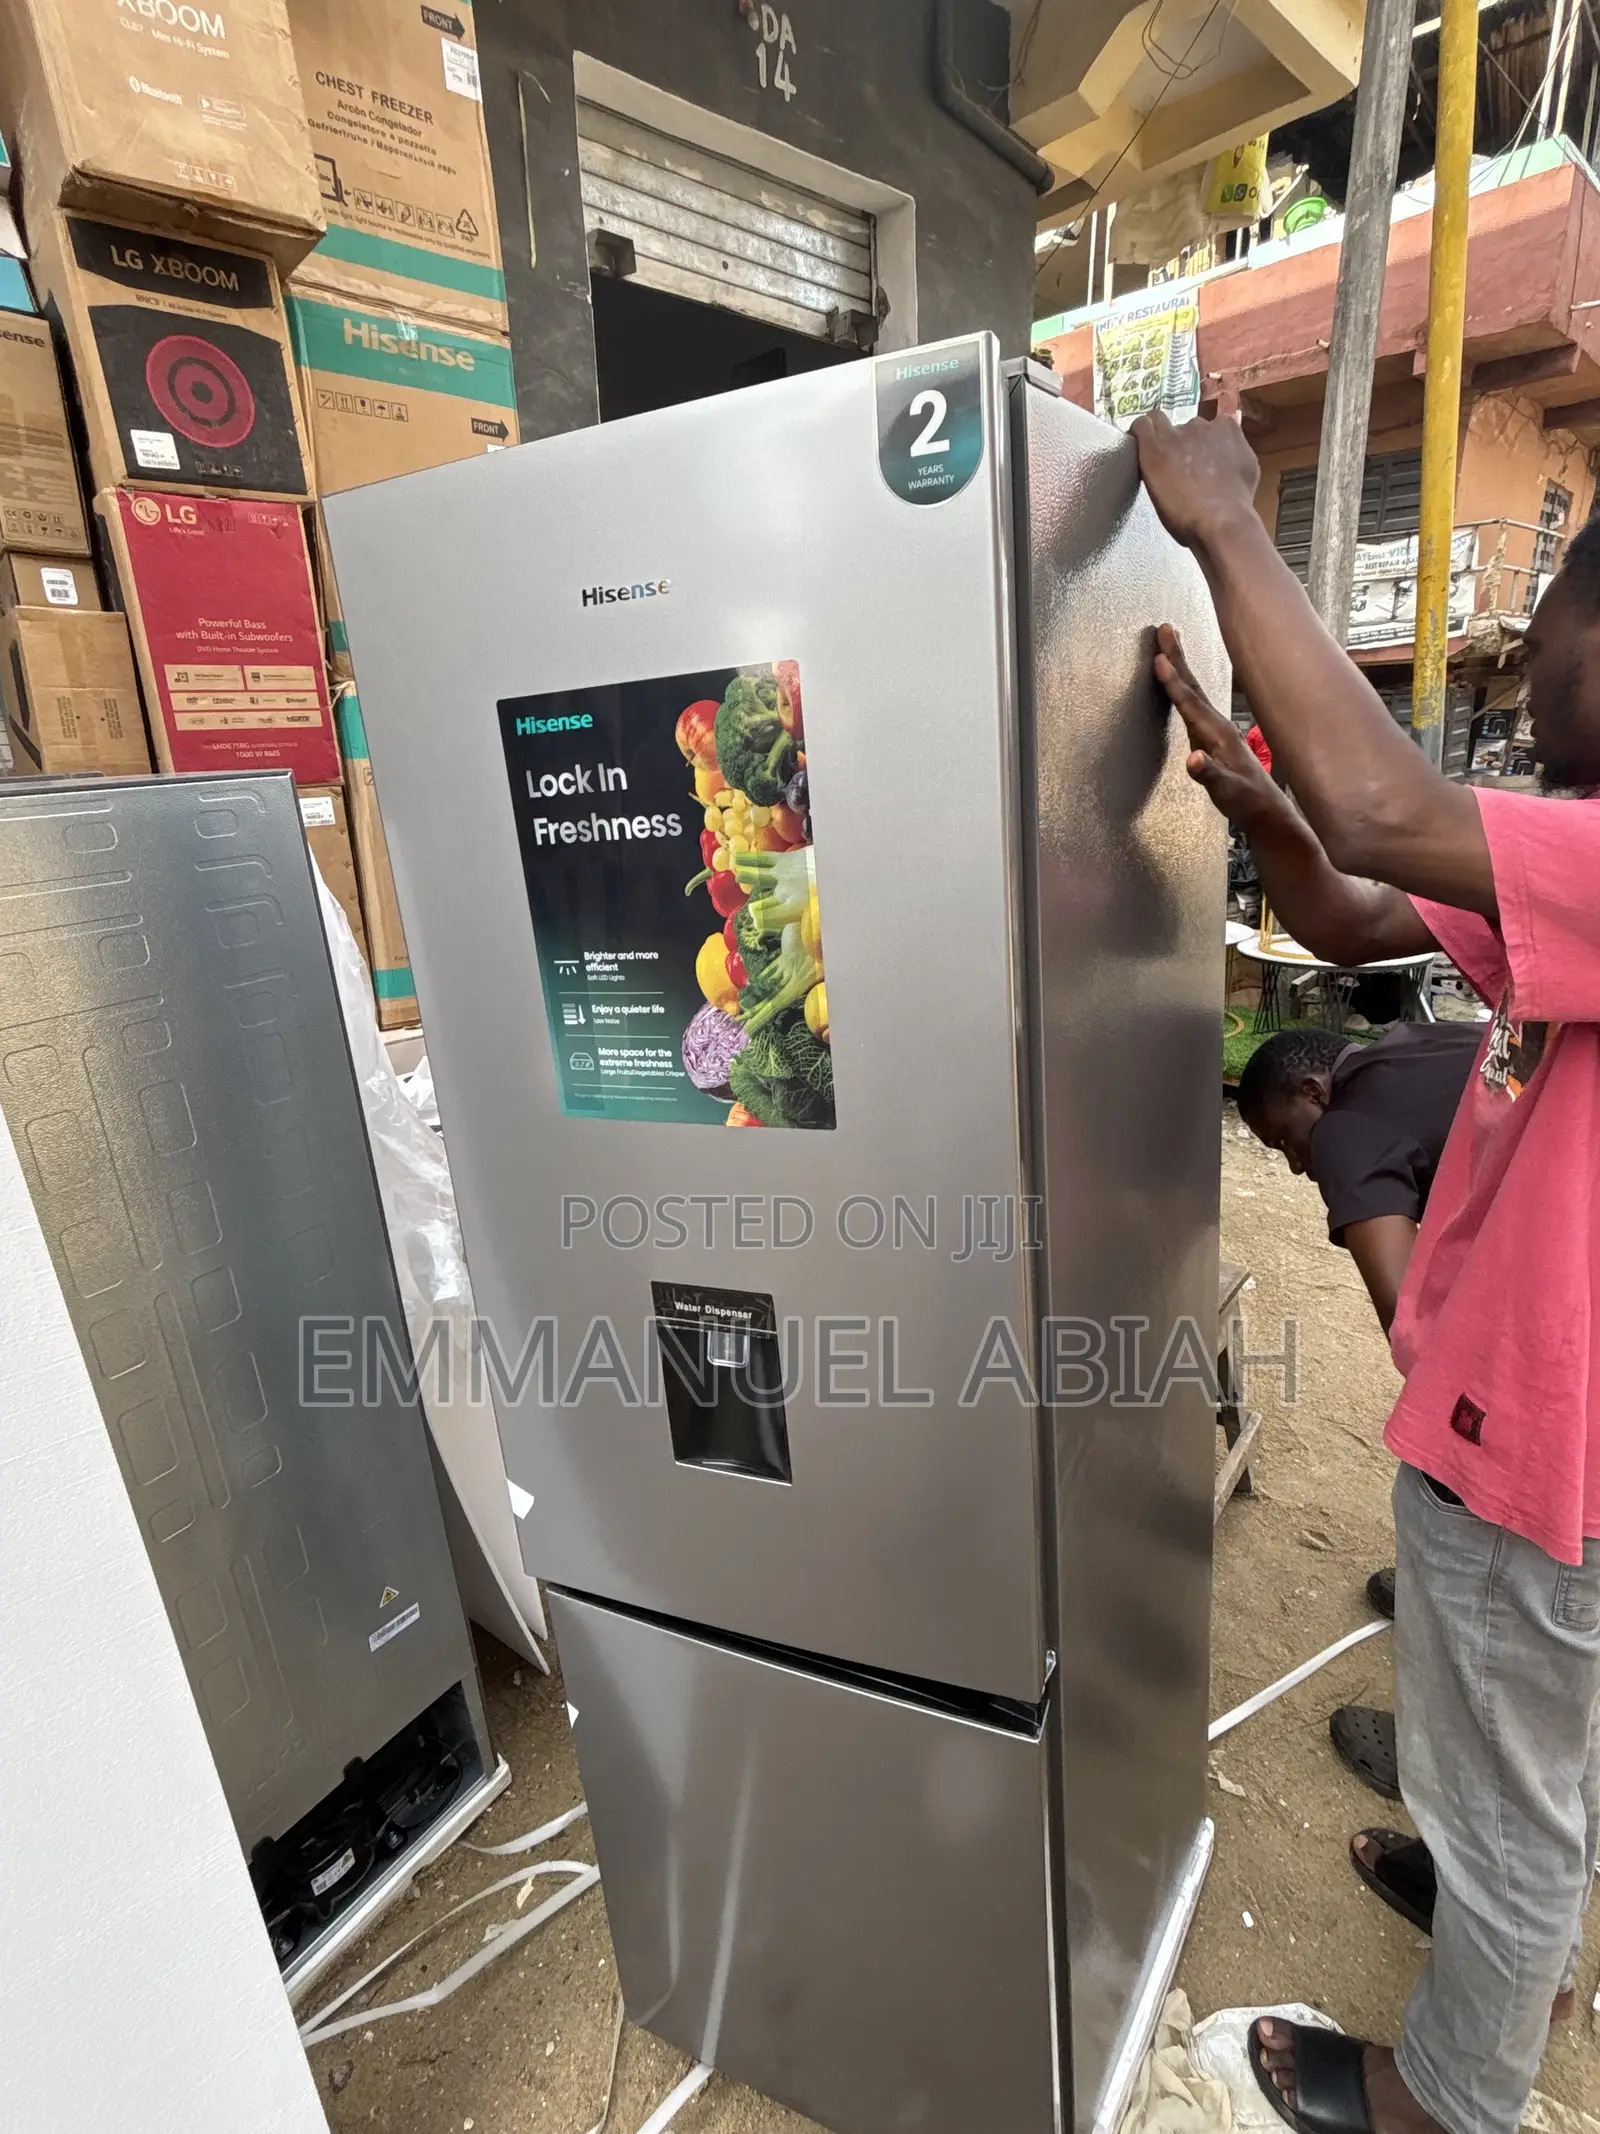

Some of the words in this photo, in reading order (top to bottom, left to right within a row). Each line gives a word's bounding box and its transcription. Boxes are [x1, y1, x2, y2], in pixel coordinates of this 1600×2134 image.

[423, 10, 453, 30] FRONT
[196, 42, 230, 59] System
[756, 43, 797, 103] 14
[315, 71, 364, 99] CHEST
[371, 90, 434, 125] FREEZER
[327, 111, 386, 138] Congelatore
[398, 137, 437, 156] pozzetto
[369, 111, 422, 138] Congelador
[110, 245, 143, 270] LG
[150, 253, 240, 292] XBOOM
[343, 317, 476, 372] Hisense
[895, 358, 960, 380] Hisense
[473, 418, 500, 435] FRONT
[909, 389, 950, 458] 2
[917, 464, 944, 476] YEARS
[908, 474, 955, 490] WARRANTY
[165, 503, 197, 525] LG
[187, 527, 205, 536] Good
[581, 578, 671, 607] Hisense
[198, 618, 242, 629] Powerful
[244, 619, 267, 629] Bass
[175, 629, 199, 640] with
[201, 630, 237, 641] Built-in
[239, 630, 294, 642] Subwoofers
[515, 712, 594, 736] Hisense
[525, 763, 595, 799] Lock
[597, 762, 628, 792] In
[532, 812, 683, 846] Freshness
[584, 951, 617, 962] Brighter
[617, 951, 634, 960] and
[635, 951, 659, 960] more
[585, 962, 619, 972] efficient
[609, 974, 626, 982] Lights
[591, 1004, 613, 1015] Enjoy
[621, 1004, 651, 1016] quieter
[651, 1004, 665, 1014] life
[598, 1047, 619, 1056] More
[619, 1048, 644, 1058] space
[645, 1048, 656, 1057] for
[657, 1048, 672, 1057] the
[599, 1059, 633, 1067] extreme
[634, 1058, 673, 1068] freshness
[600, 1068, 616, 1076] Large
[664, 1070, 685, 1078] Crisper
[674, 1301, 702, 1312] Water
[705, 1304, 753, 1319] Dispenser
